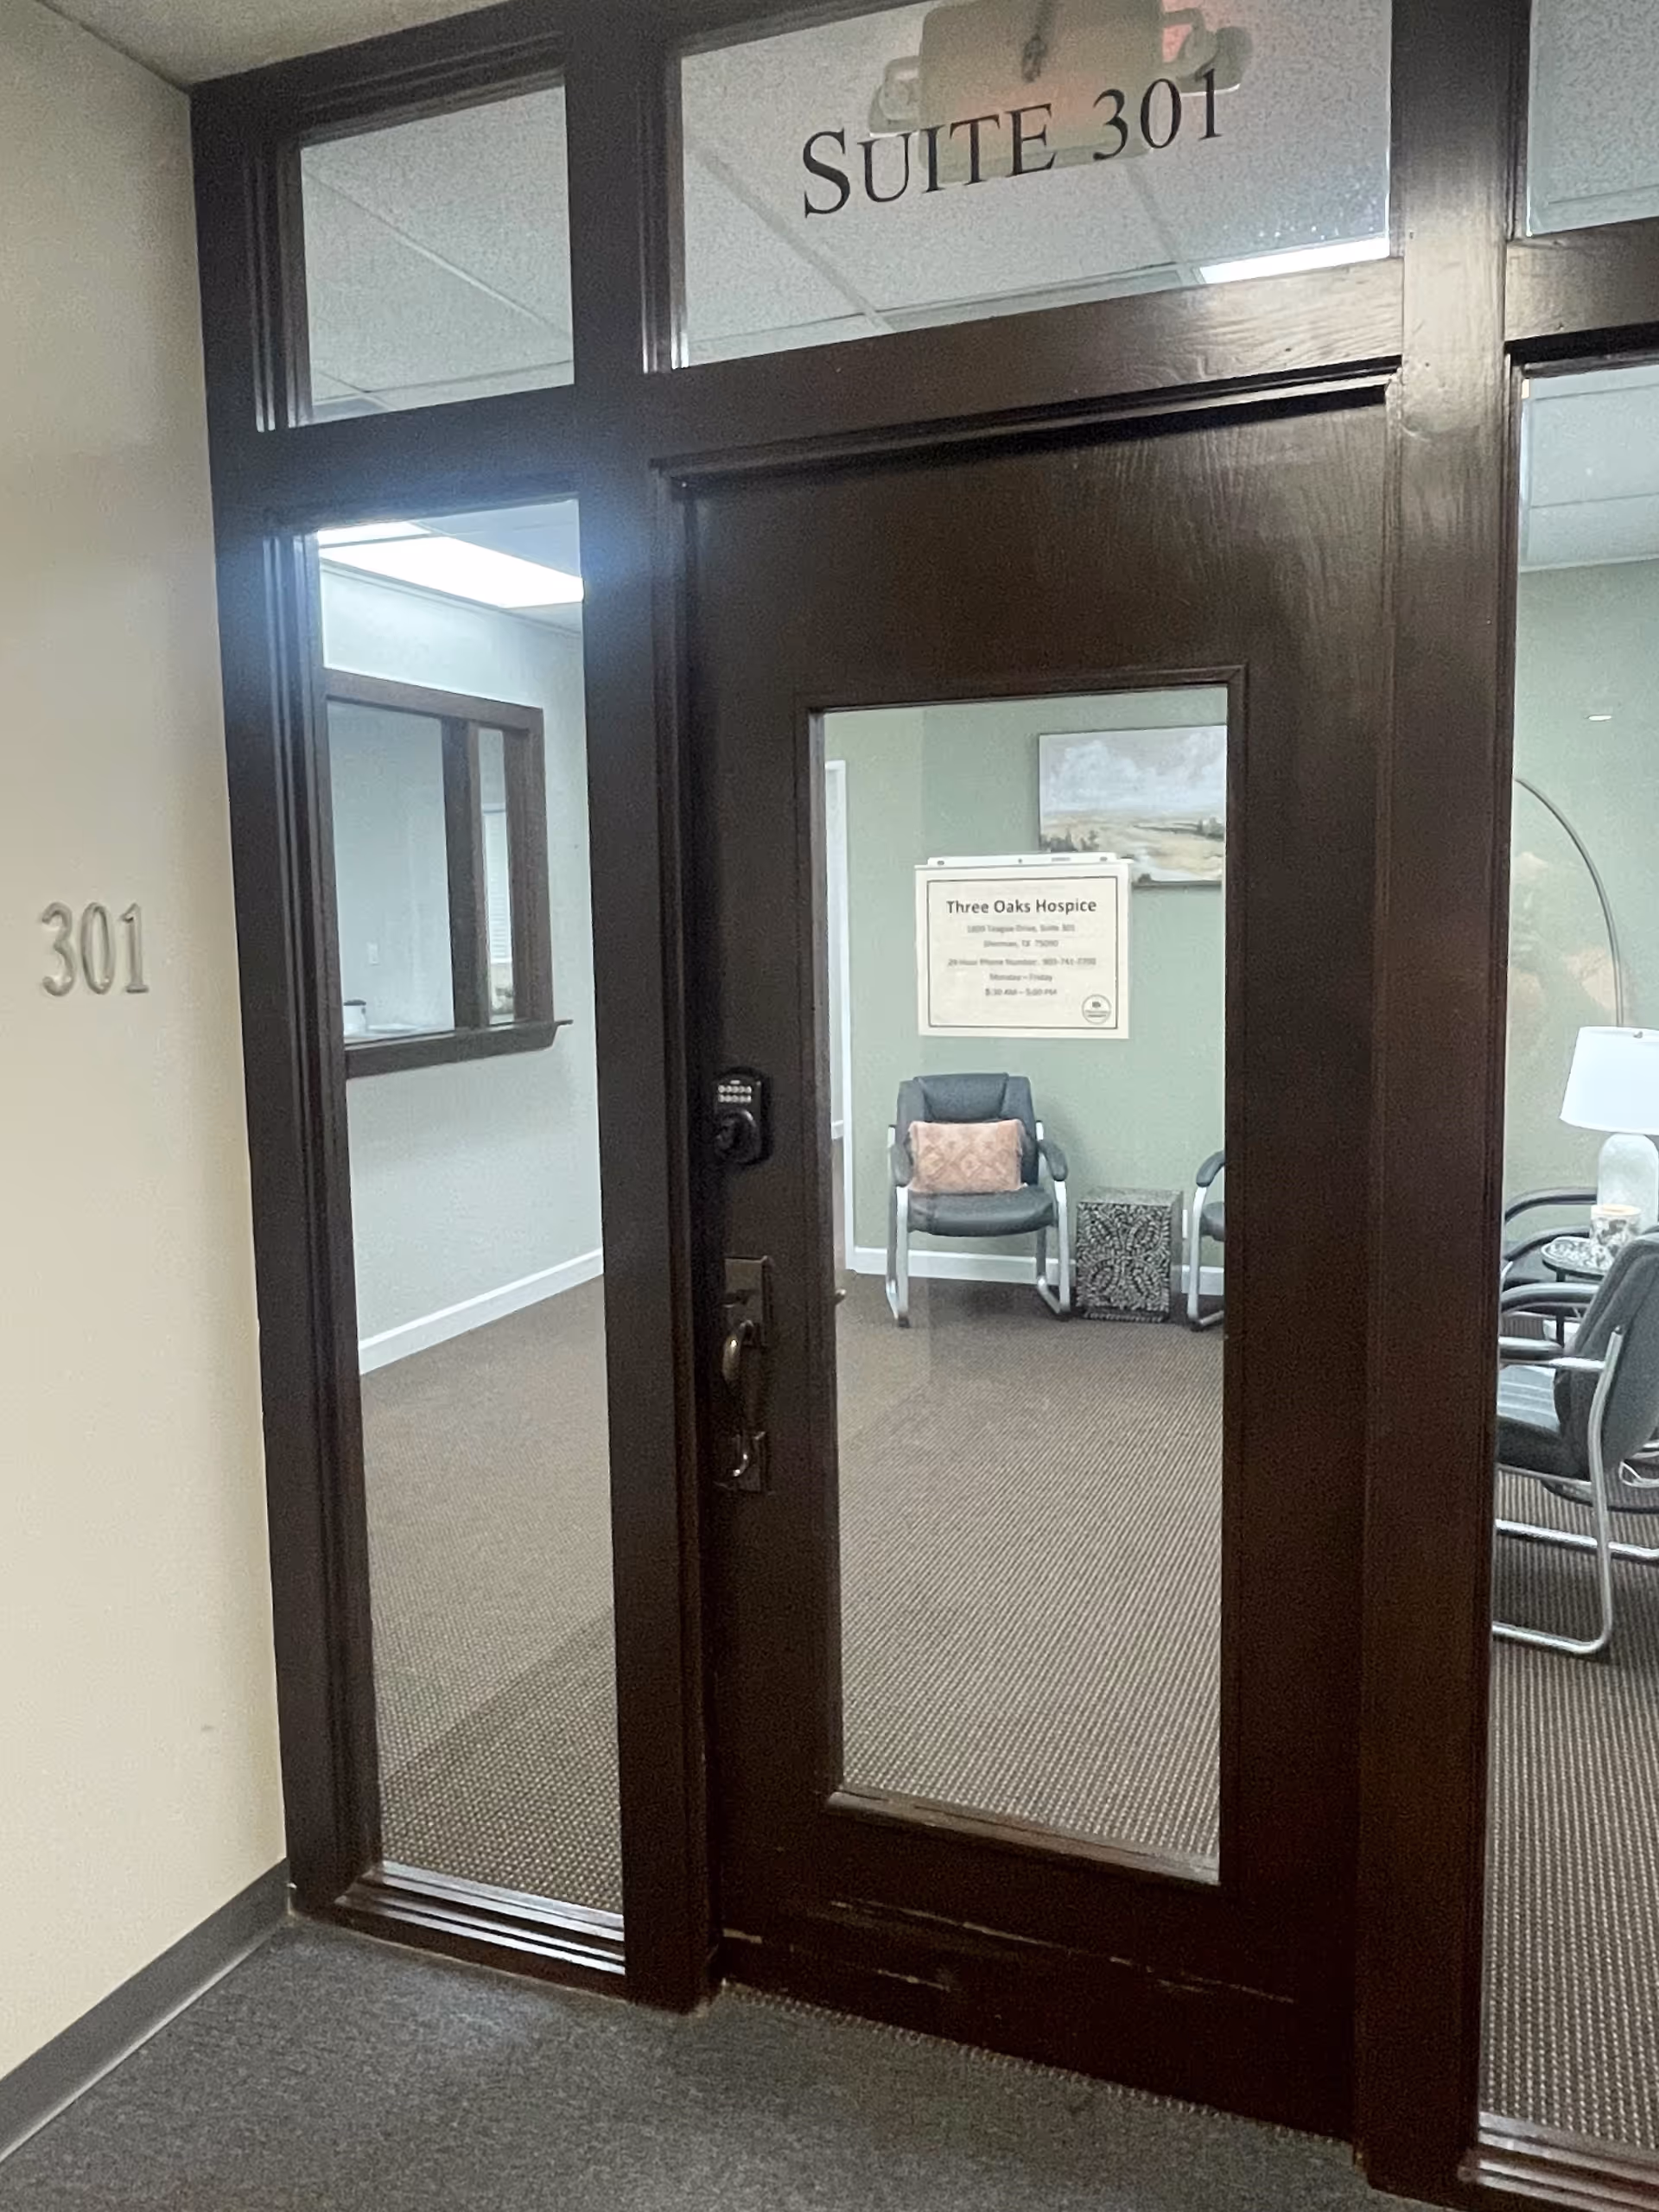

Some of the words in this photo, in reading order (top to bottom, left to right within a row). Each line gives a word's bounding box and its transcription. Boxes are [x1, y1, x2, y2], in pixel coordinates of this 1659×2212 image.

[802, 103, 1058, 219] SUITE
[1092, 67, 1224, 162] 301
[946, 899, 989, 914] Three
[994, 899, 1031, 913] Oaks
[1036, 898, 1097, 915] Hospice
[41, 901, 149, 997] 301
[1029, 972, 1053, 982] Friday
